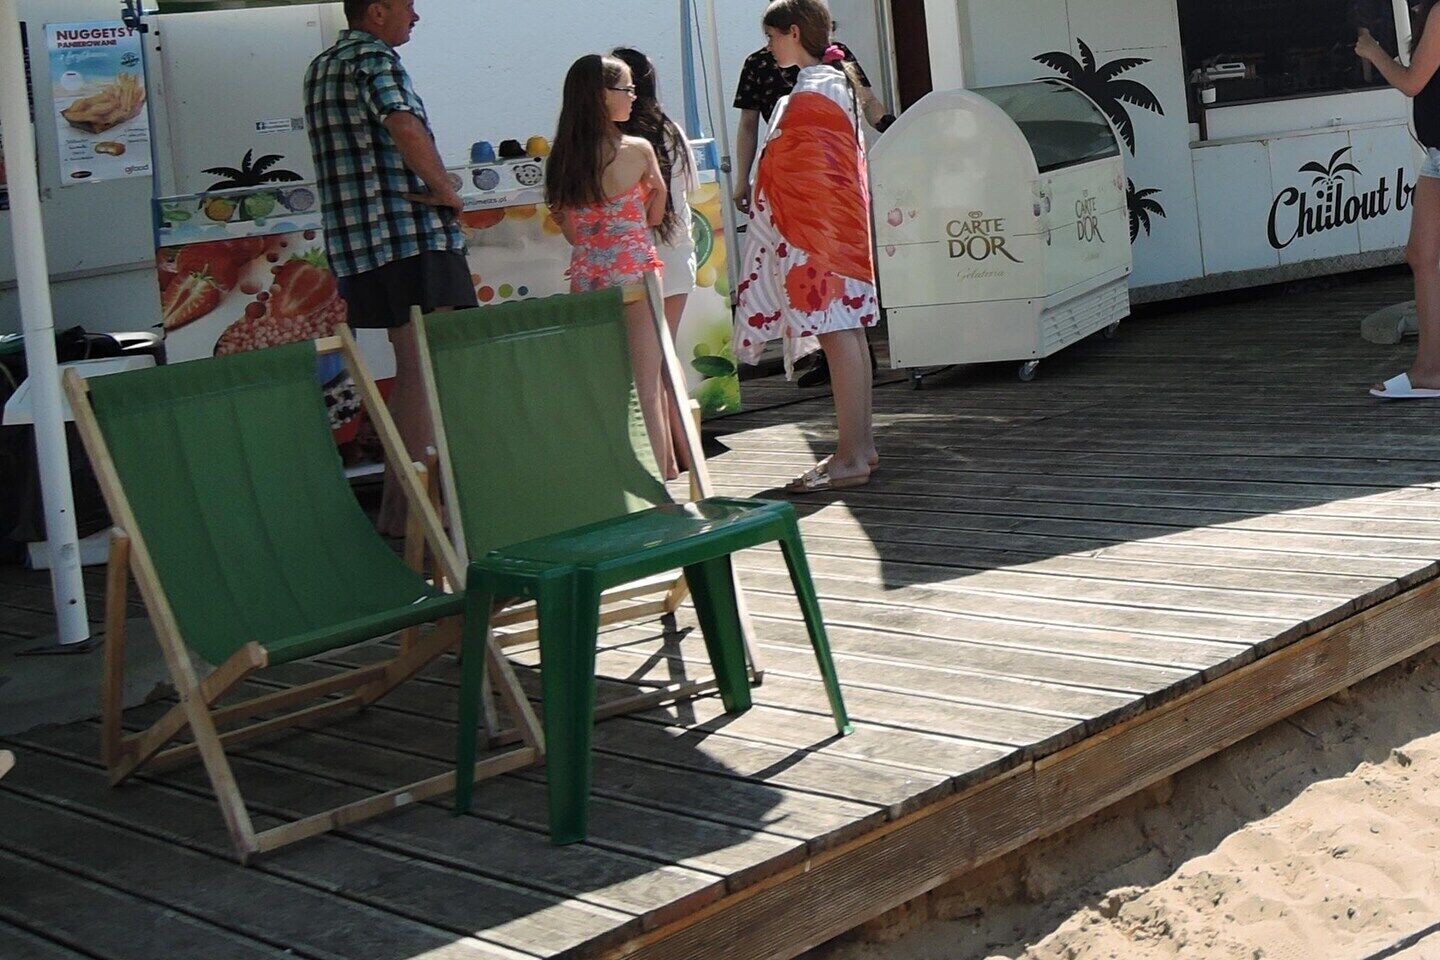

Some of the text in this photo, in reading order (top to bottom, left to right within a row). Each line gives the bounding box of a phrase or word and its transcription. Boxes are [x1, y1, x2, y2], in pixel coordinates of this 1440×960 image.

[56, 26, 135, 41] NUGGETSY
[1075, 197, 1097, 219] CARTE
[946, 218, 1006, 238] CARTE
[948, 235, 1025, 264] D'OR
